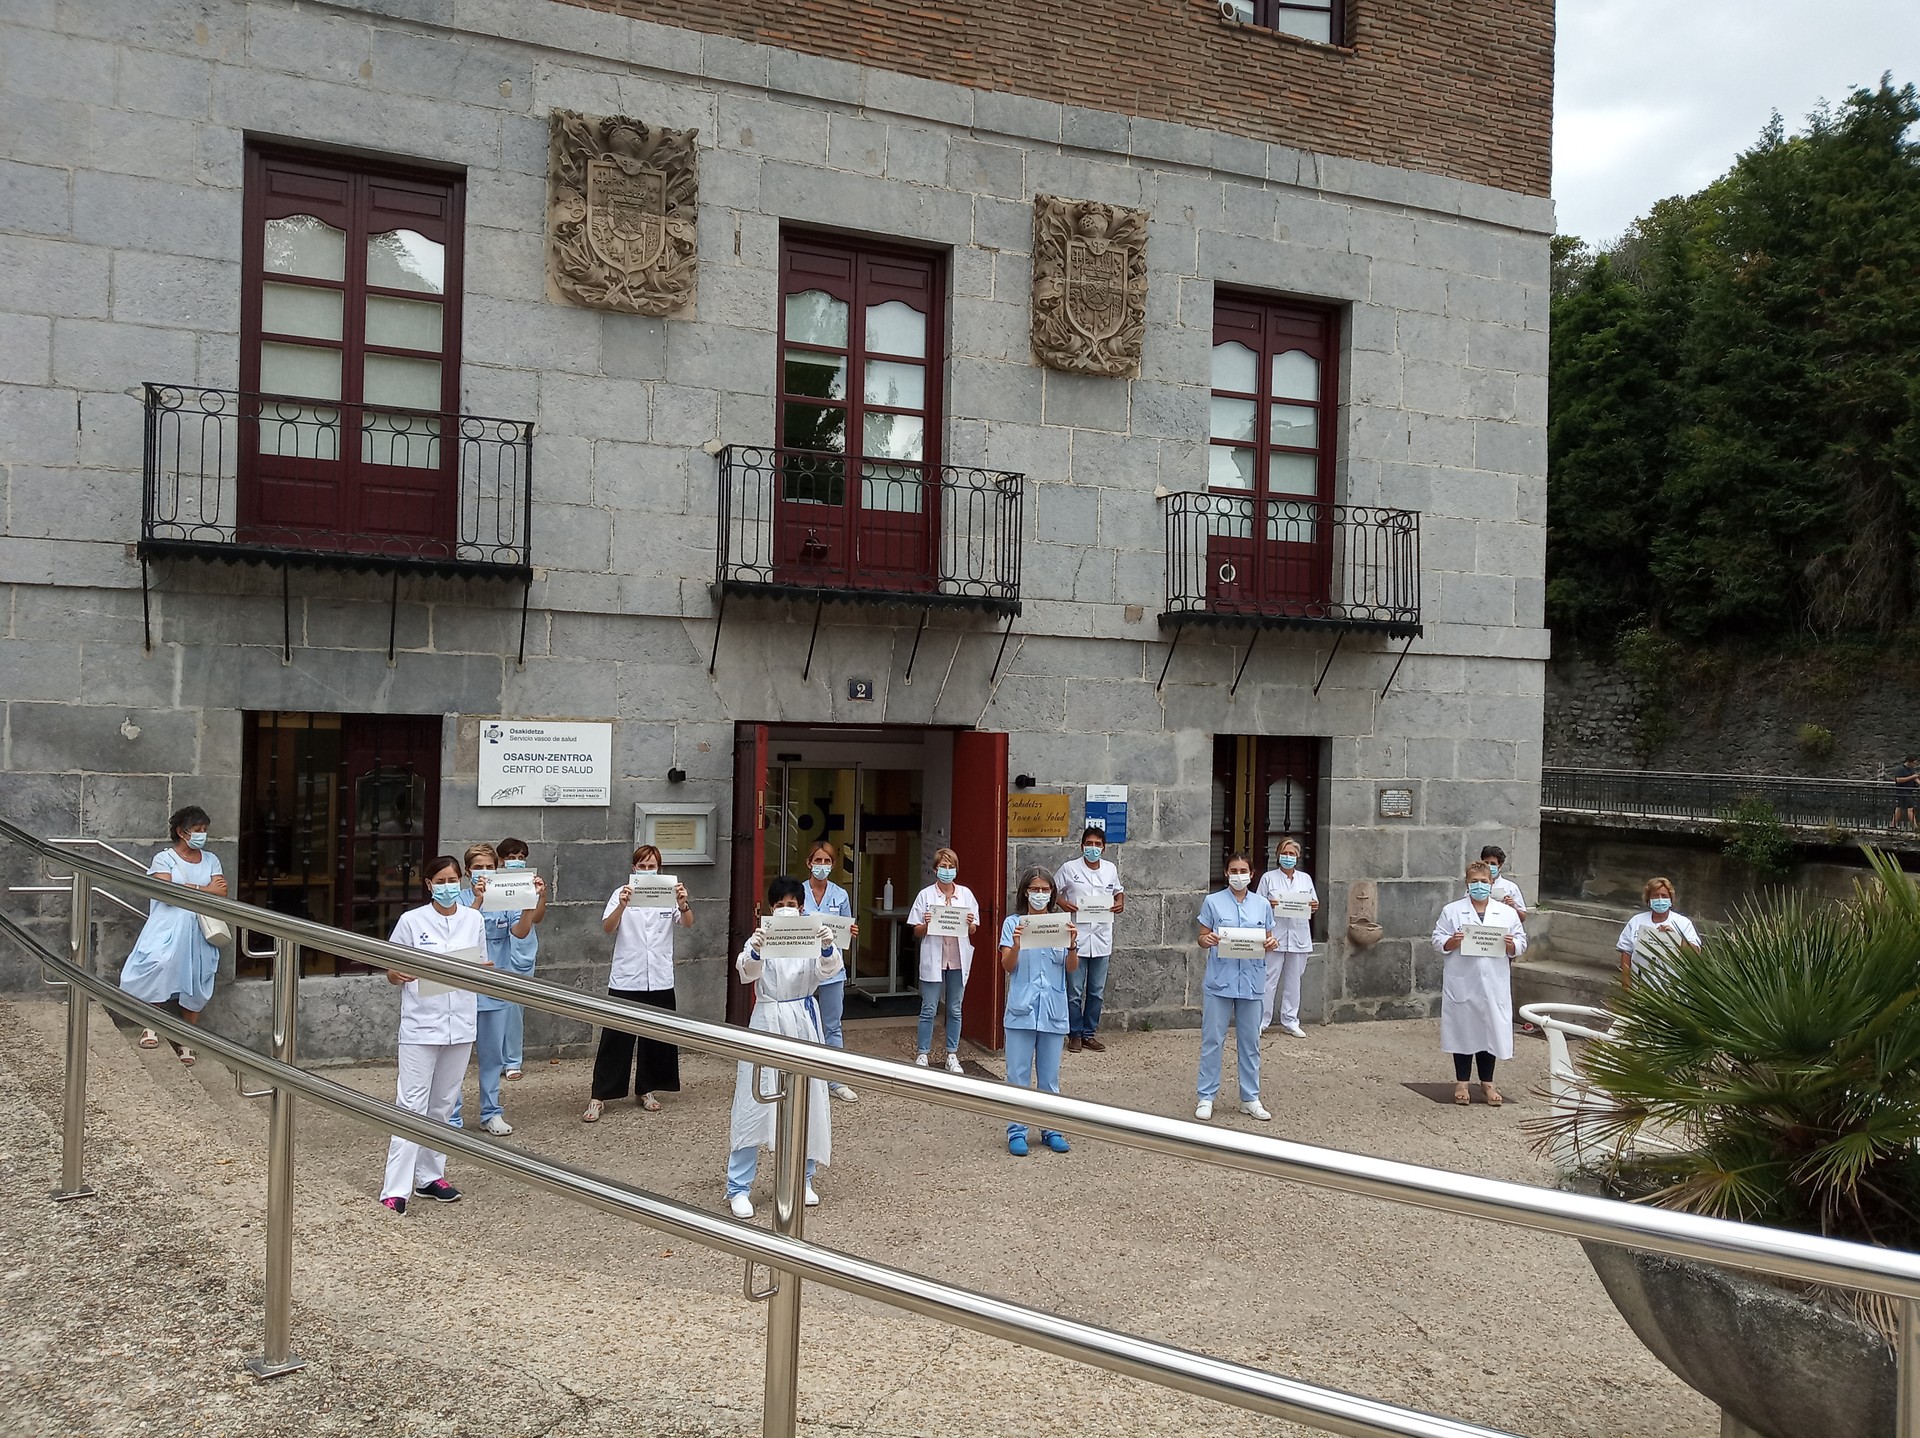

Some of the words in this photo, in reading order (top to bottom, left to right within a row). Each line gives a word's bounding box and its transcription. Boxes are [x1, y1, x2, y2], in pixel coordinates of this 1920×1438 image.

[856, 683, 866, 698] 2
[503, 753, 593, 762] OSASUN-ZENTROA
[502, 765, 543, 774] CENTRO
[545, 765, 559, 774] DE
[561, 766, 593, 774] SALUD
